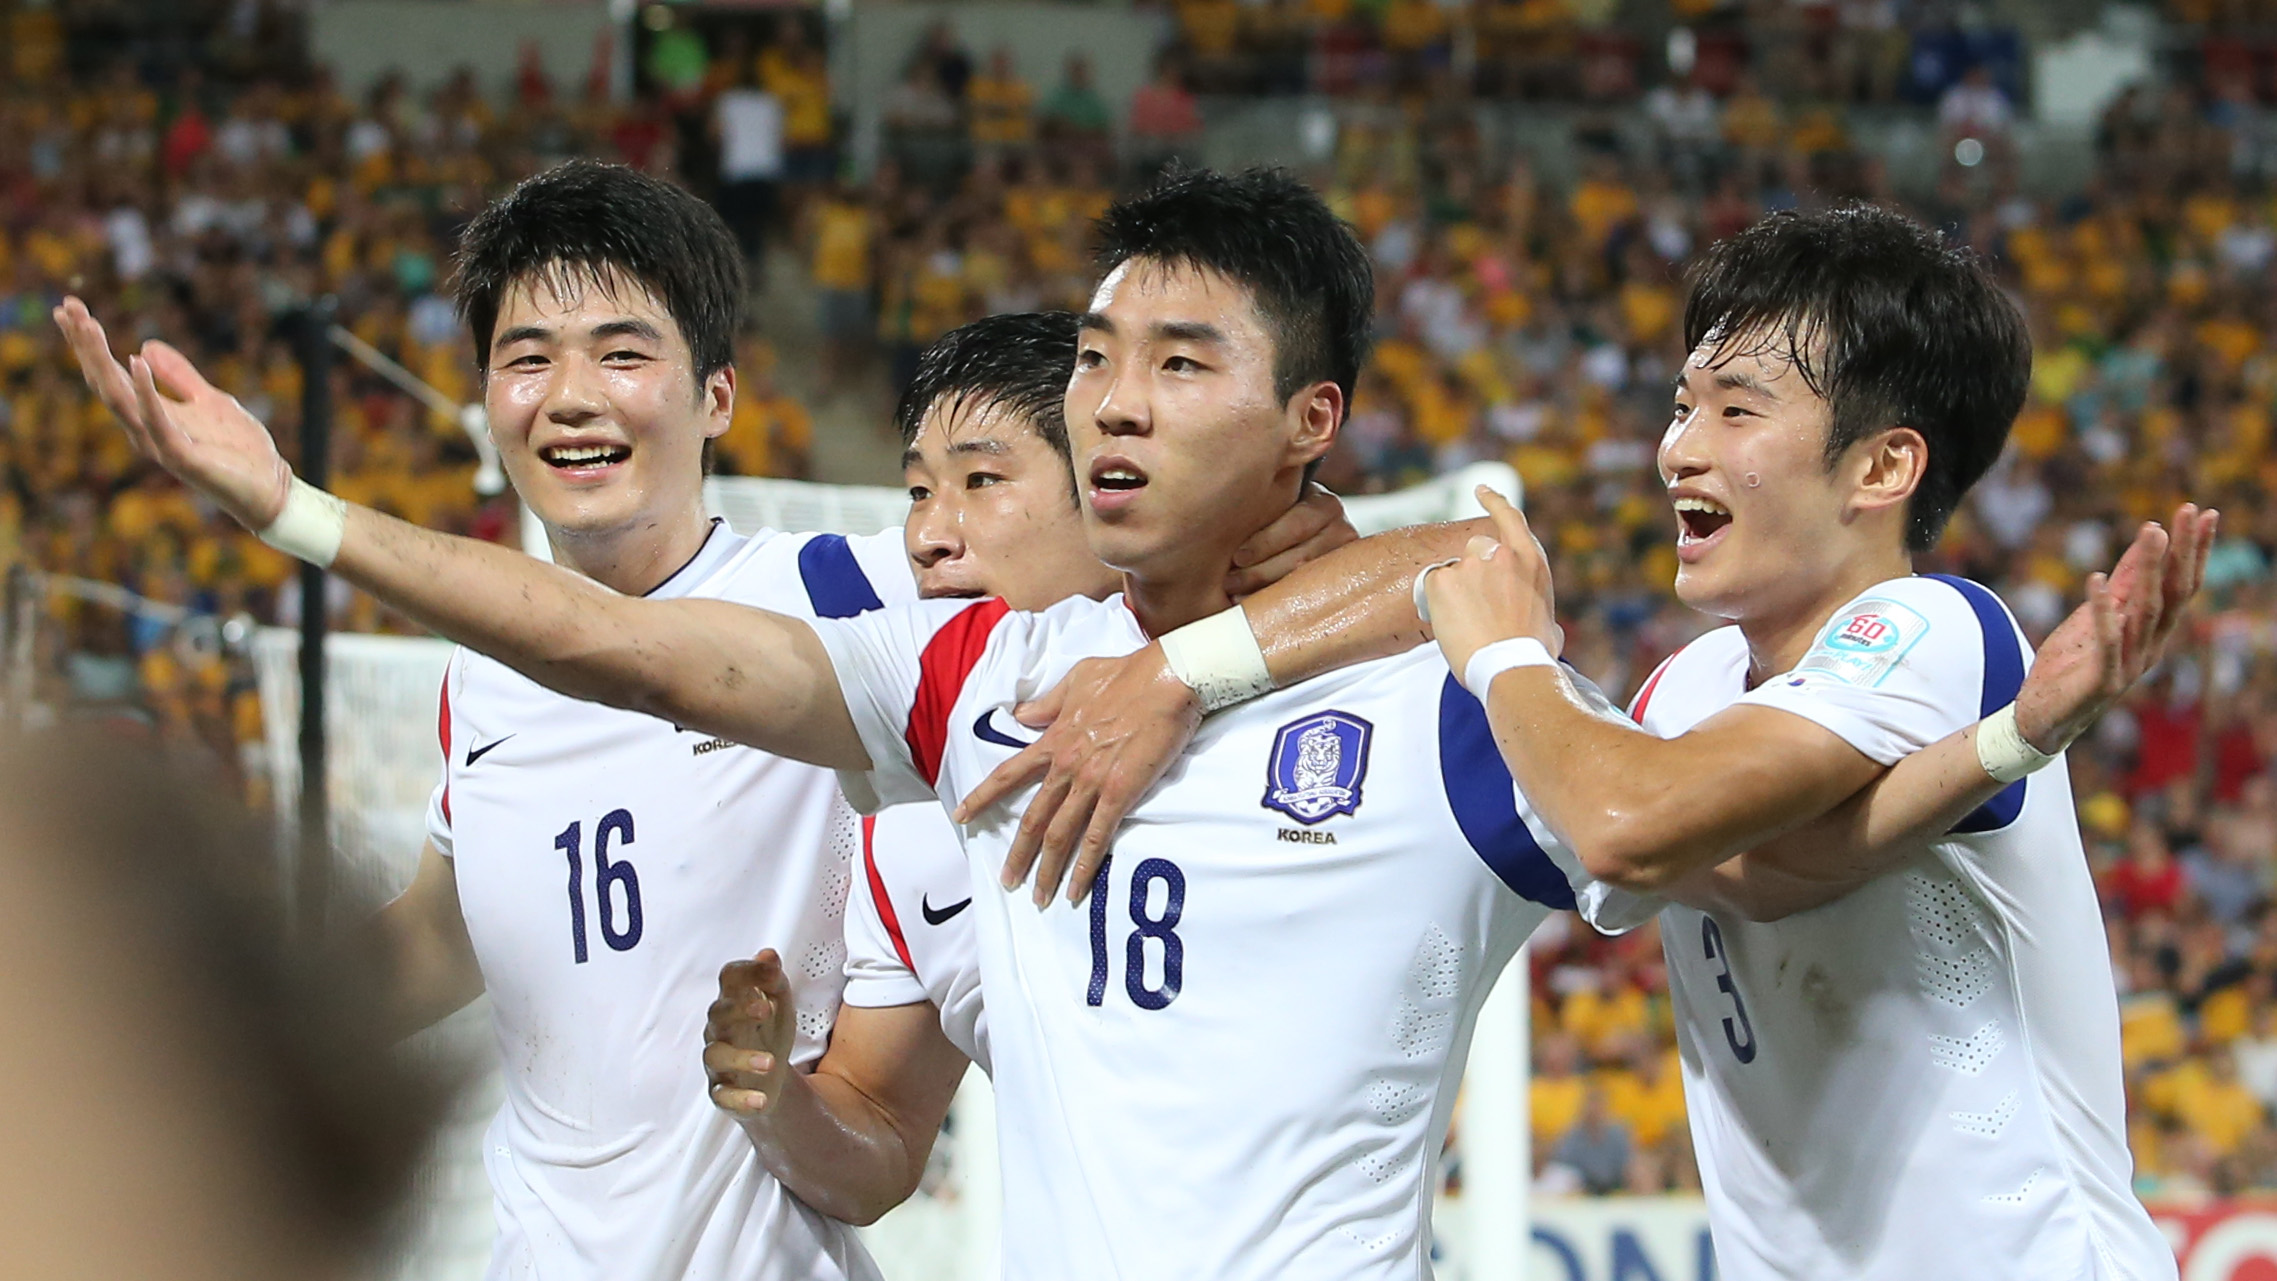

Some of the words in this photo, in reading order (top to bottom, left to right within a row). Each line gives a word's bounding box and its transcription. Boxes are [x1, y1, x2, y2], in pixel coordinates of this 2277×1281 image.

[1840, 634, 1871, 646] minutes
[1847, 616, 1886, 639] 60
[1277, 827, 1338, 845] KOREA
[554, 807, 644, 965] 16
[1086, 853, 1186, 1011] 18
[1702, 914, 1757, 1065] 3
